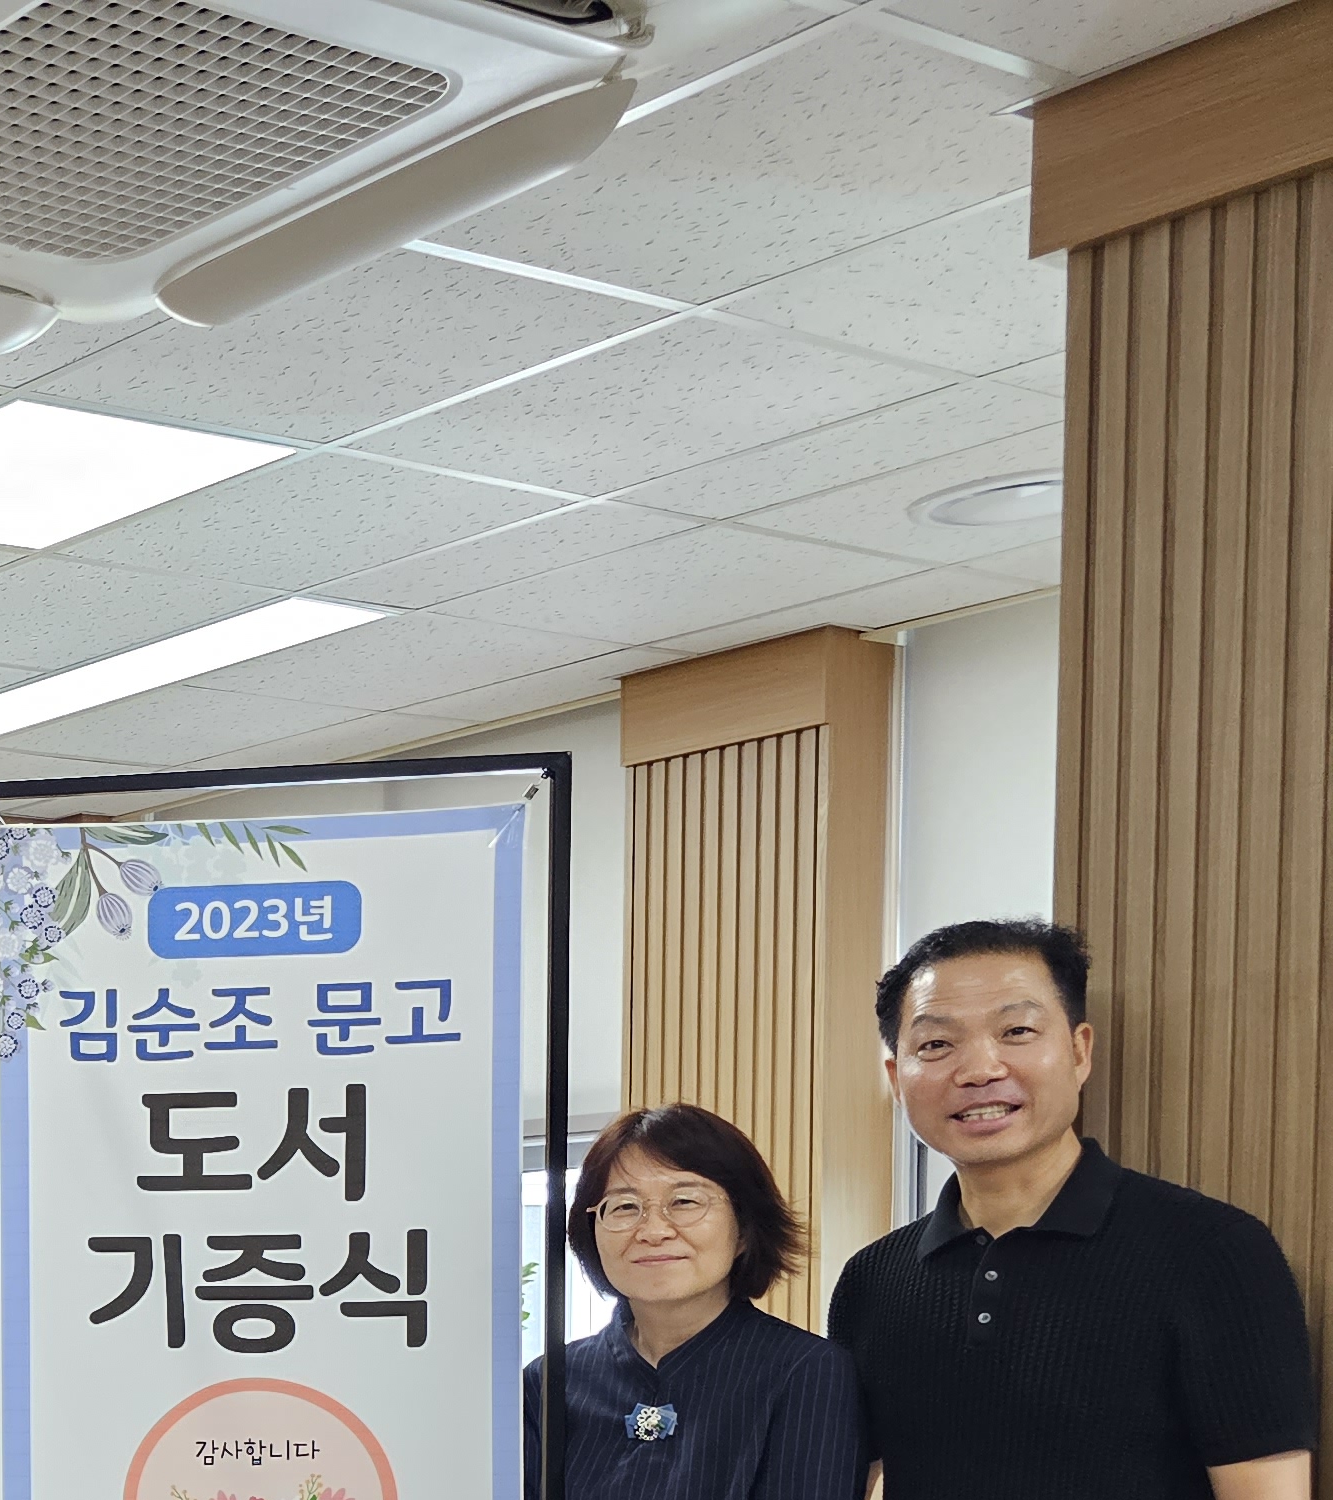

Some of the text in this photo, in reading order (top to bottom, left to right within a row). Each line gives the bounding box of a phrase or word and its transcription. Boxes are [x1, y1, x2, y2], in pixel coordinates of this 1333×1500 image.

[173, 893, 334, 943] 2023년
[58, 978, 462, 1064] 김순조 문고
[136, 1083, 367, 1202] 도서
[88, 1229, 428, 1354] 기증식
[194, 1438, 321, 1466] 감사합니다
